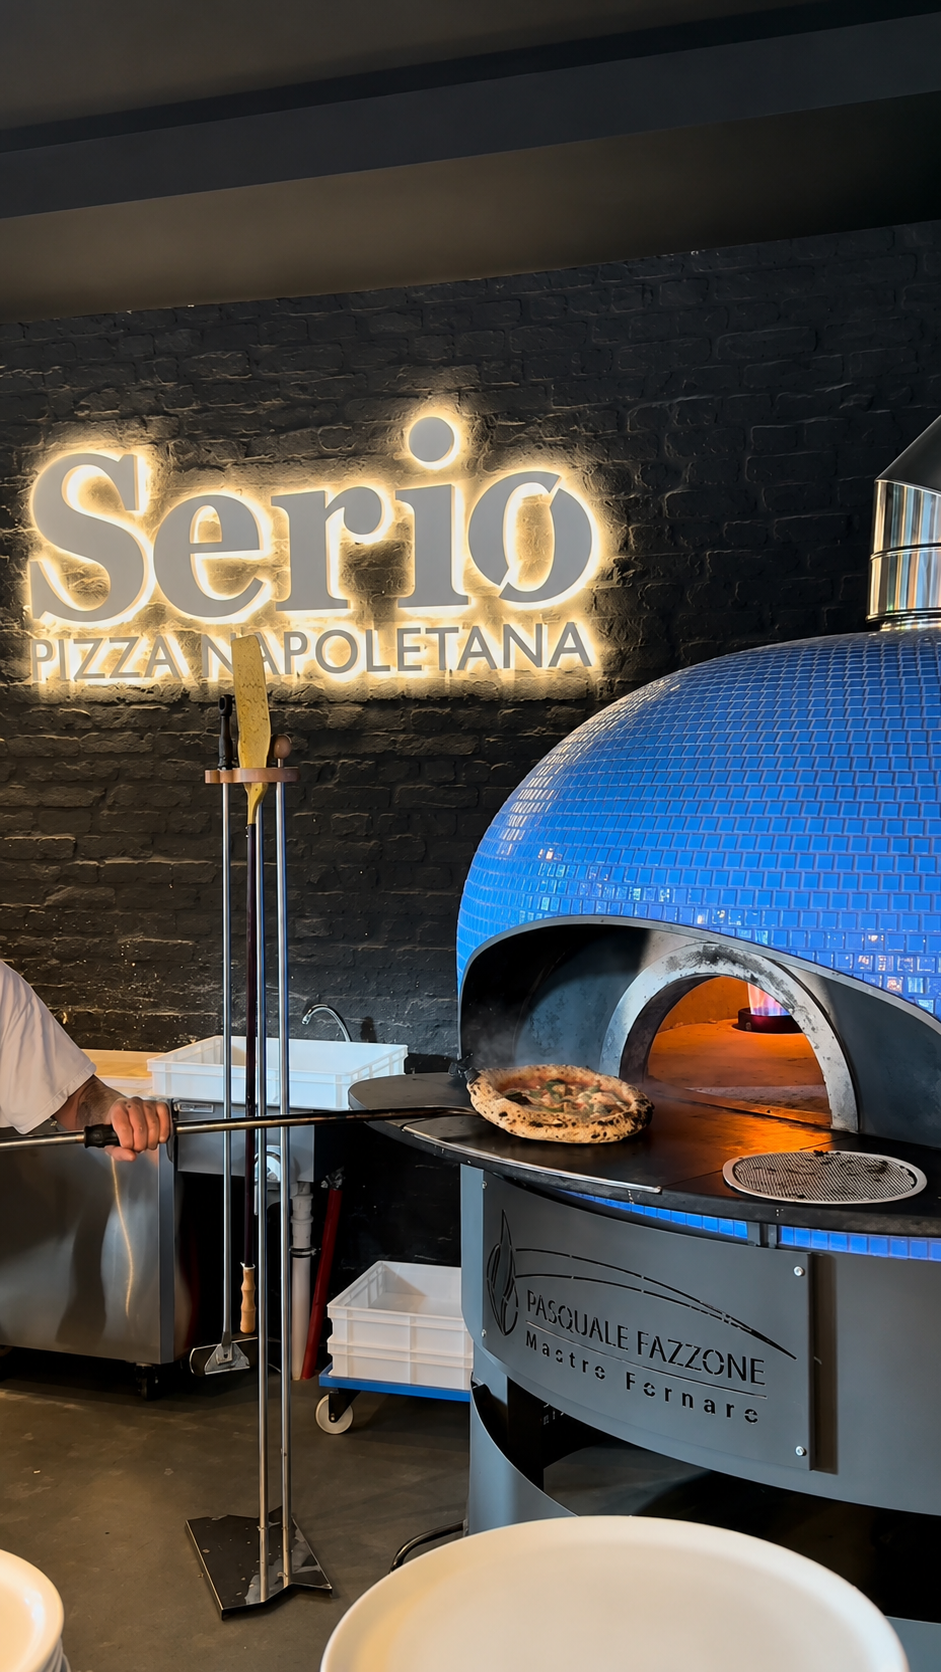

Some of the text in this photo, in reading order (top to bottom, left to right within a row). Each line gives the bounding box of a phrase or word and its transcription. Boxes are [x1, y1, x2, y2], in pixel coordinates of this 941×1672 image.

[29, 416, 593, 623] Serio
[31, 636, 181, 681] PIZZA
[525, 1331, 759, 1424] Mastro Fornaro
[526, 1290, 766, 1386] PASQUALE FAZZONE
